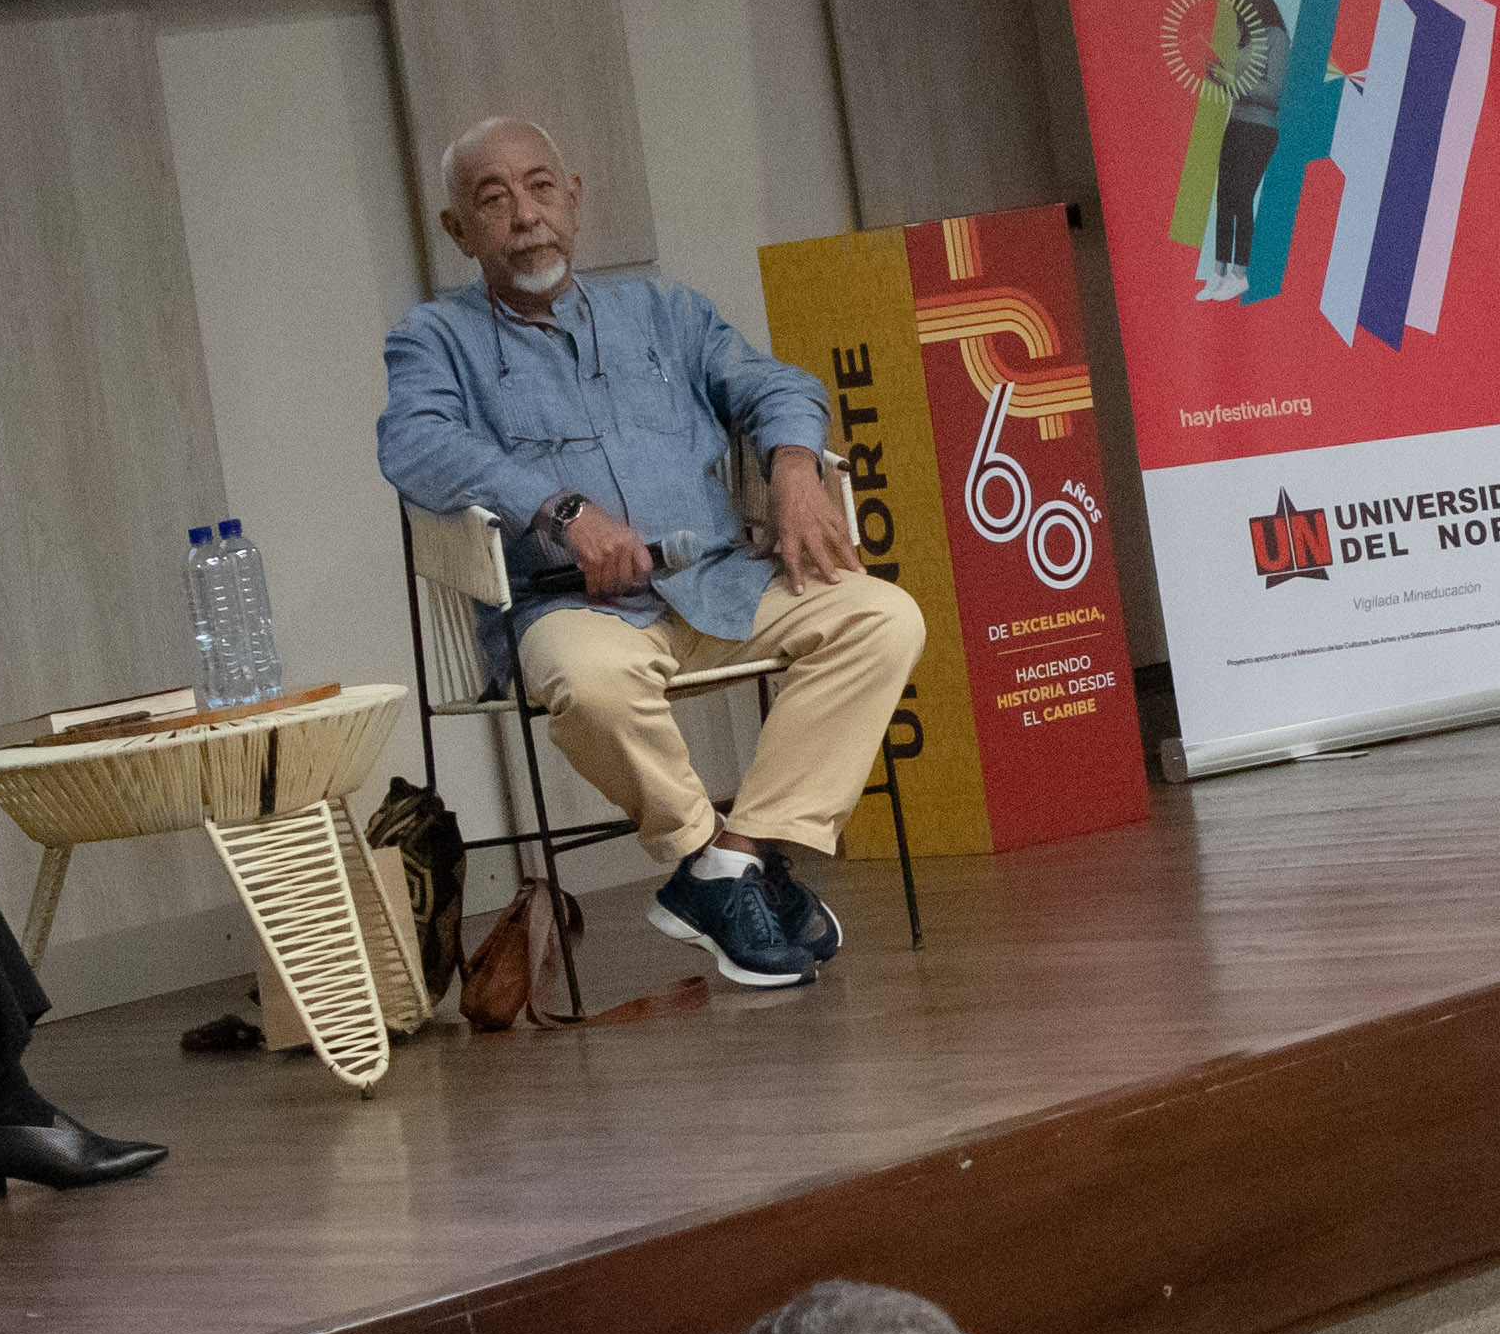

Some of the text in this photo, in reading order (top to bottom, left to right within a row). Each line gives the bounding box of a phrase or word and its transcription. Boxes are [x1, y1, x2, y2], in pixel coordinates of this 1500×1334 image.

[1179, 396, 1313, 428] hayfestival.org
[965, 381, 1093, 589] 60
[1061, 478, 1103, 524] AÑOS
[1250, 511, 1333, 574] UN
[1339, 532, 1409, 564] DEL
[1352, 581, 1481, 613] Vigilada Mineducación
[988, 606, 1105, 642] DE EXCELENCIA,
[1016, 655, 1091, 683] HACIENDO
[997, 671, 1116, 710] HISTORIA DESDE
[1023, 697, 1096, 727] EL CARIBE
